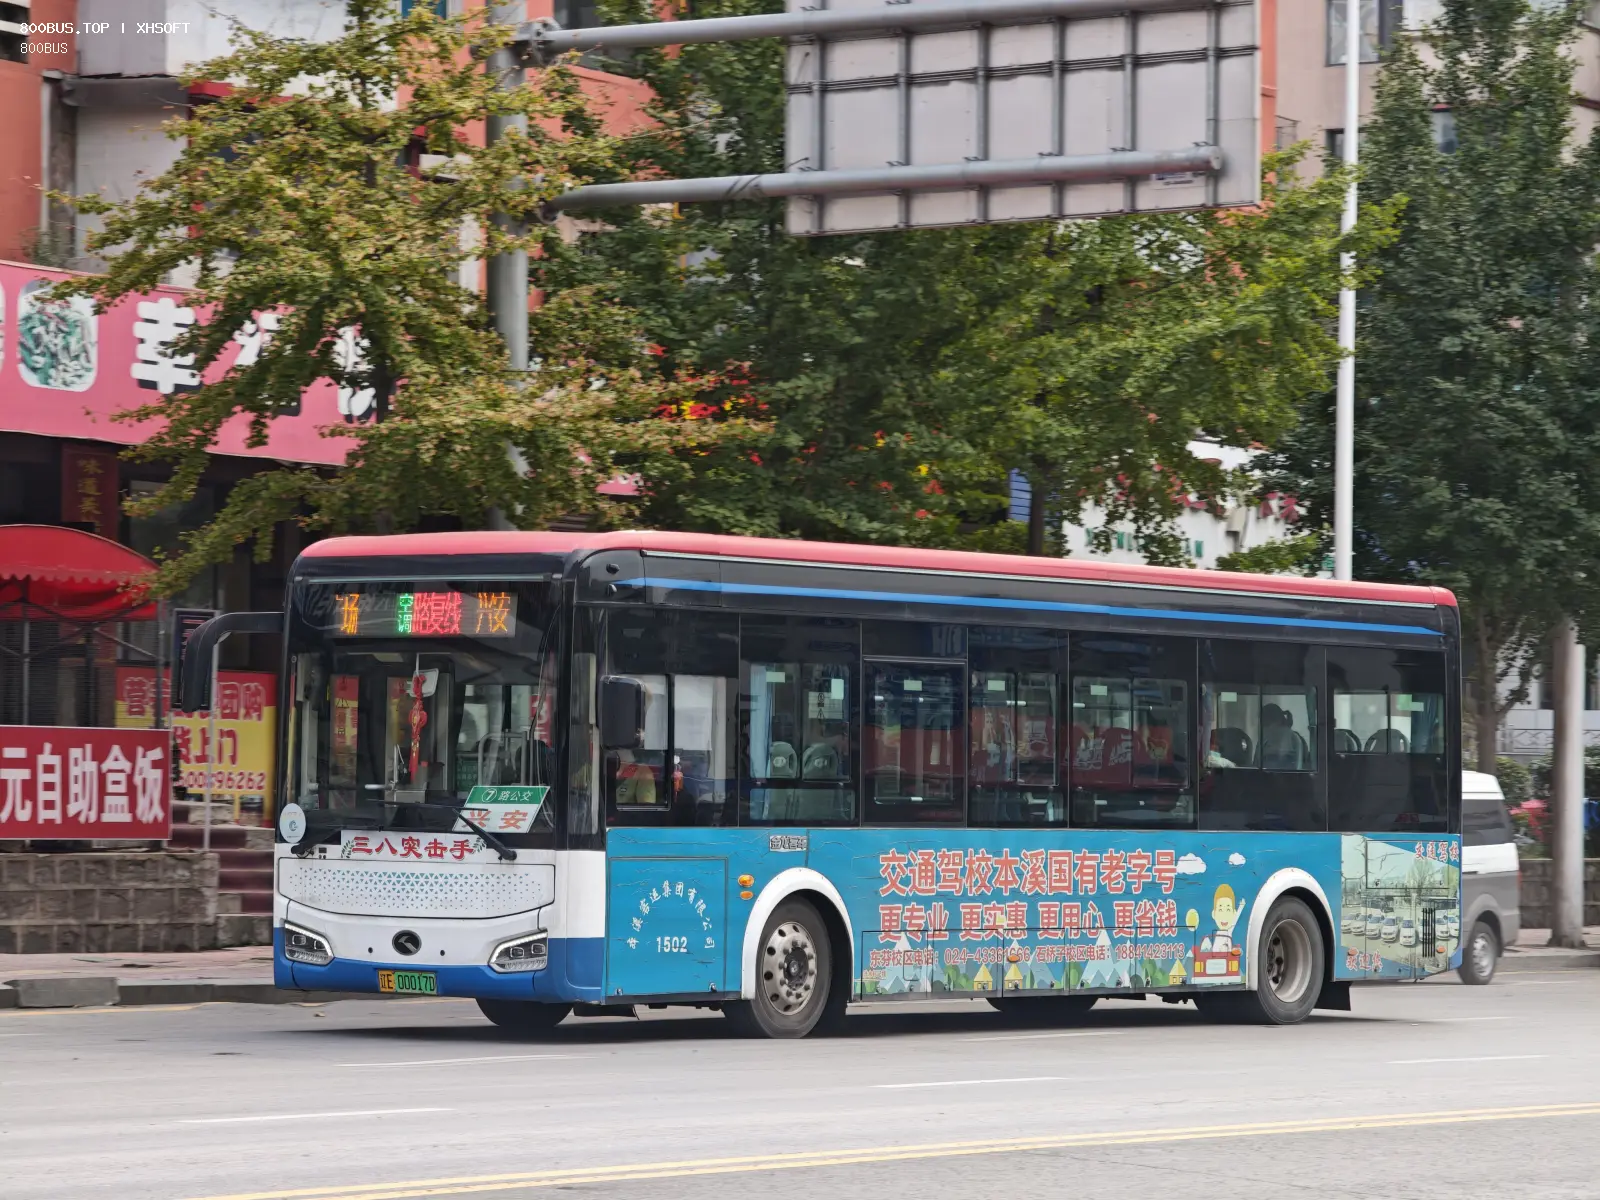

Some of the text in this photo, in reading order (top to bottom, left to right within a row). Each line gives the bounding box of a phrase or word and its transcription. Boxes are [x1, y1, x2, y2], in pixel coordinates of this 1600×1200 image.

[0, 741, 165, 825] 元自助盒饭
[351, 836, 475, 861] 三八突击手
[879, 849, 1178, 896] 交通驾校本溪国有老字号
[878, 900, 1177, 943] 更专业 更实惠 更用心 更省钱
[656, 936, 688, 953] 1502
